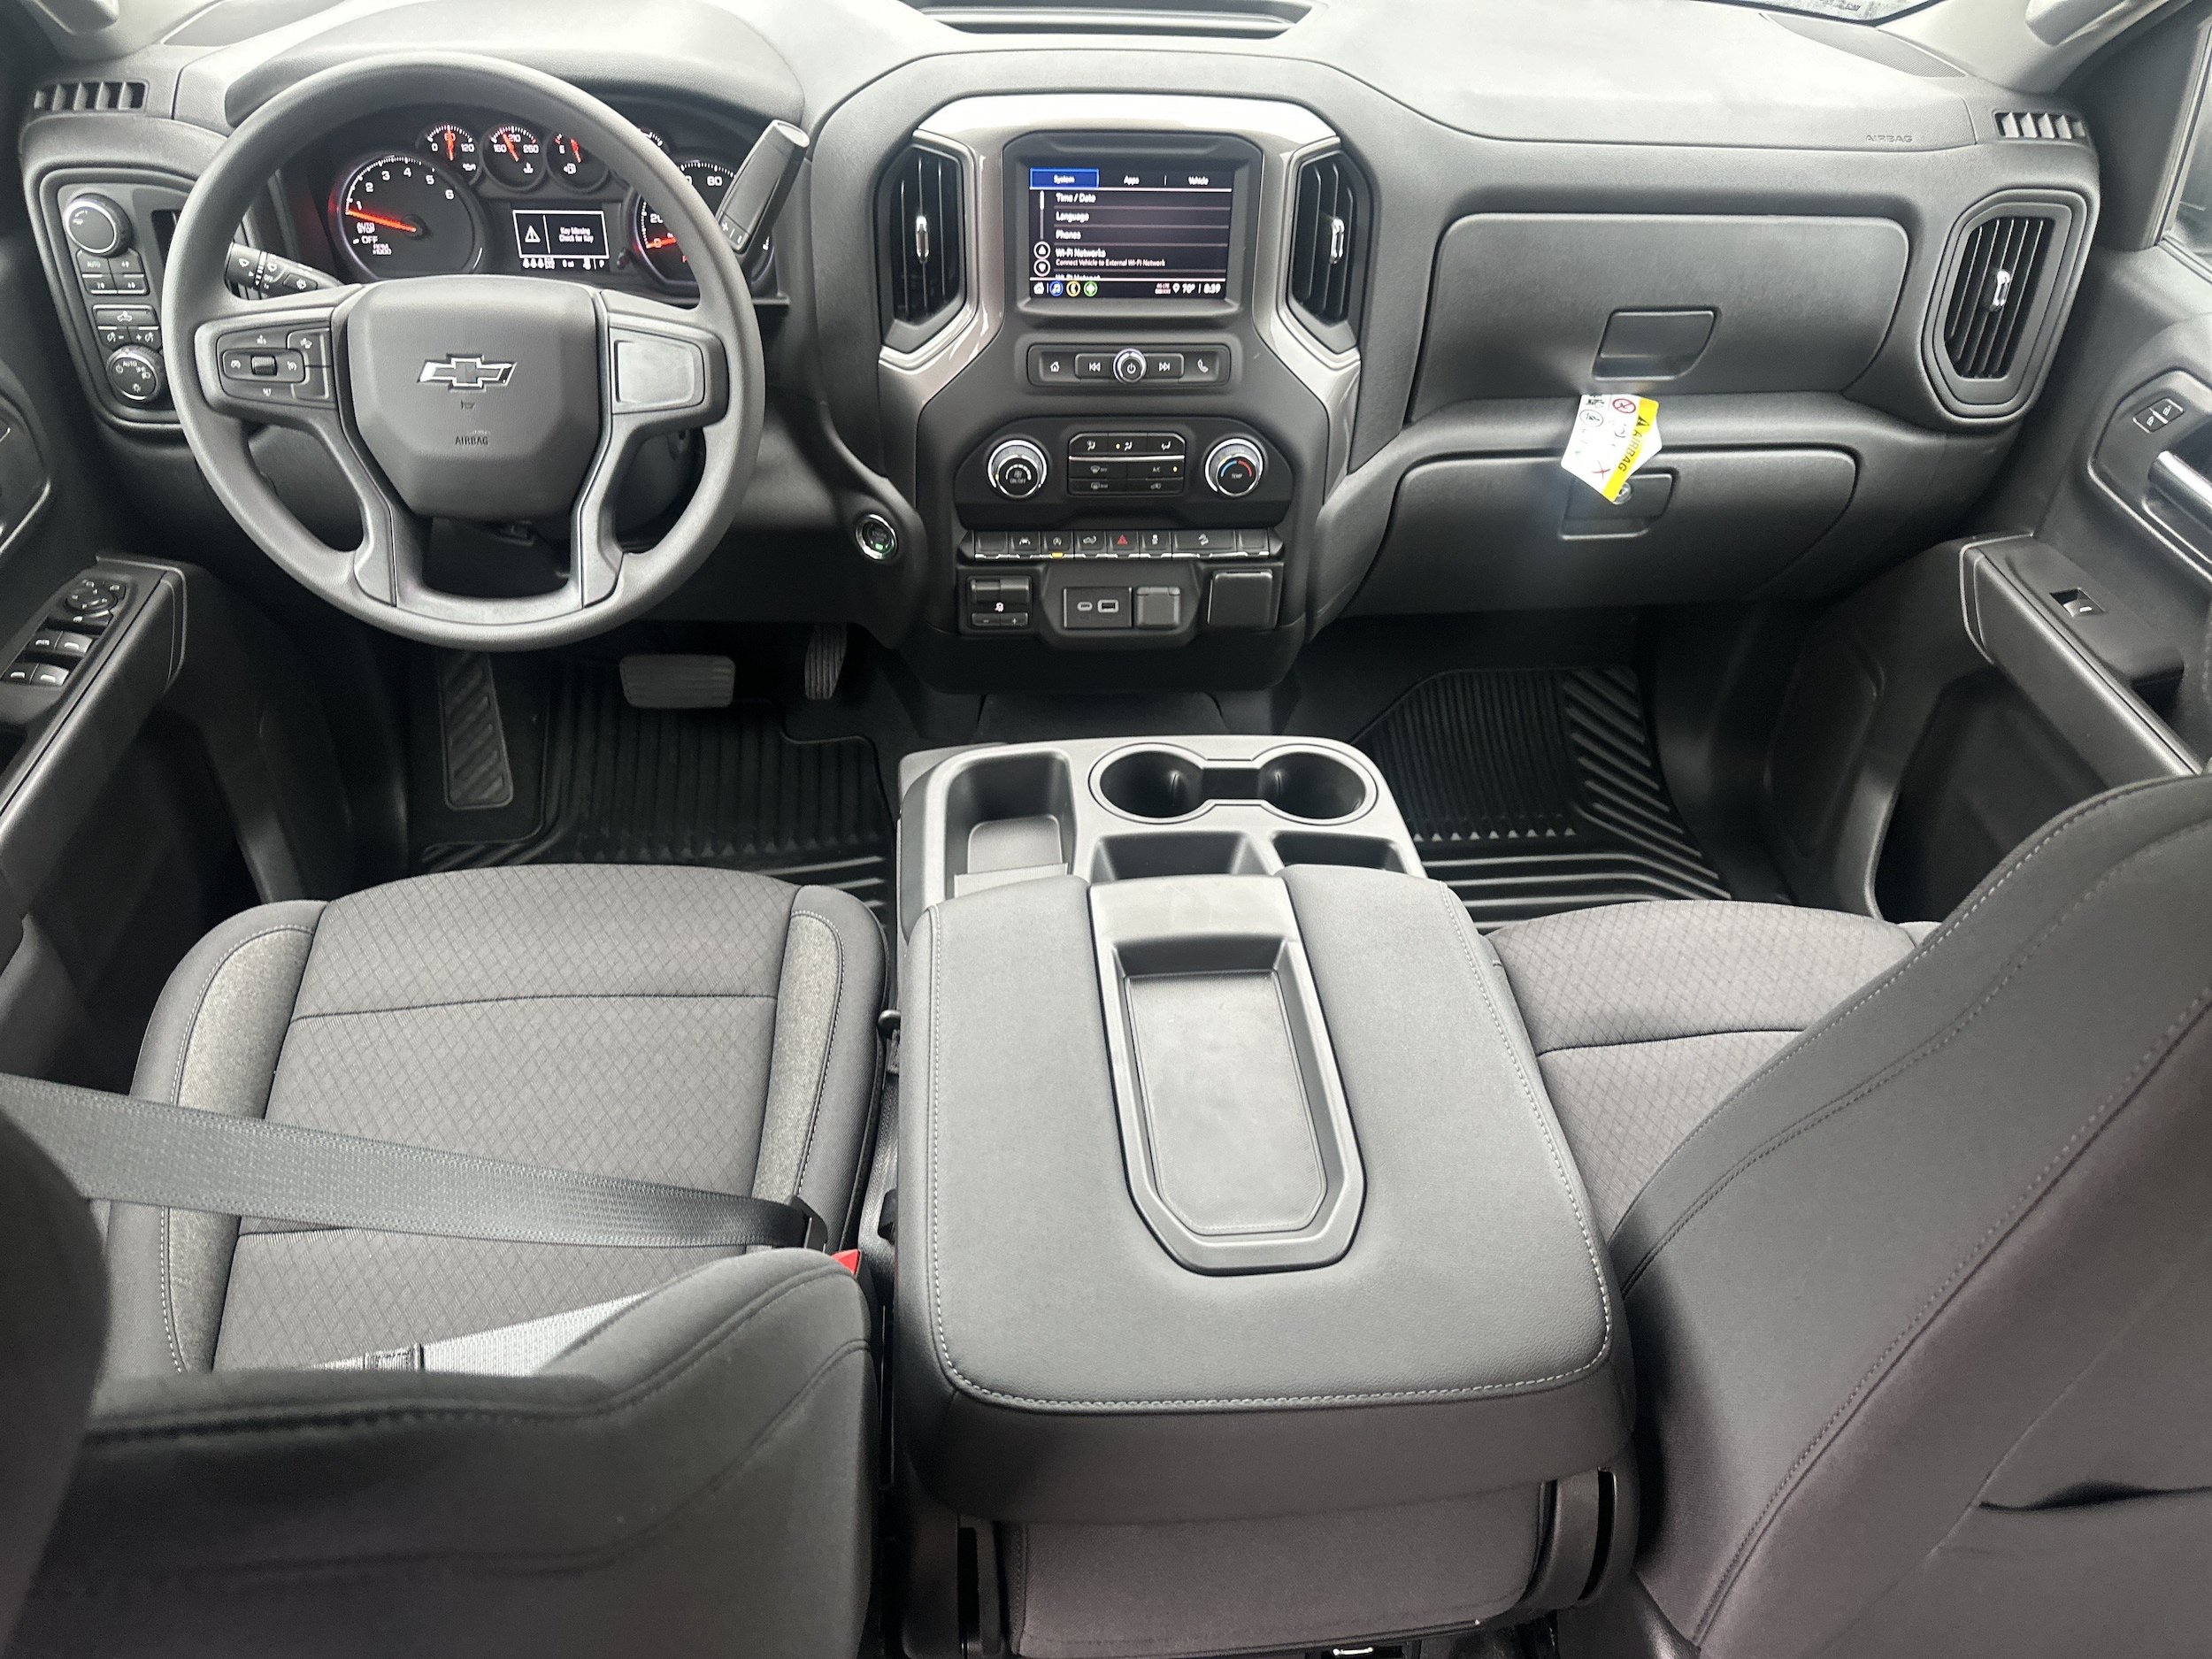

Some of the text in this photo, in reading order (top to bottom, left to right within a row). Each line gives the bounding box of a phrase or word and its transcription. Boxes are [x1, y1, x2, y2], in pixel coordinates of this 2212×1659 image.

[461, 143, 474, 152] 120
[381, 171, 390, 180] 3
[403, 167, 411, 177] 4
[426, 175, 434, 185] 5
[1054, 174, 1075, 184] System
[1124, 175, 1140, 186] Apps
[1188, 176, 1209, 185] Vehicle
[365, 182, 373, 192] 2
[445, 189, 455, 199] 6
[1056, 192, 1073, 203] Time
[1079, 193, 1096, 203] Date
[356, 200, 362, 211] 1
[1056, 211, 1089, 223] Language
[1056, 230, 1081, 240] Phones
[1056, 248, 1106, 257] Wi-Fi Networks
[455, 435, 488, 445] AIRBAG
[1617, 429, 1643, 472] AIRBAG
